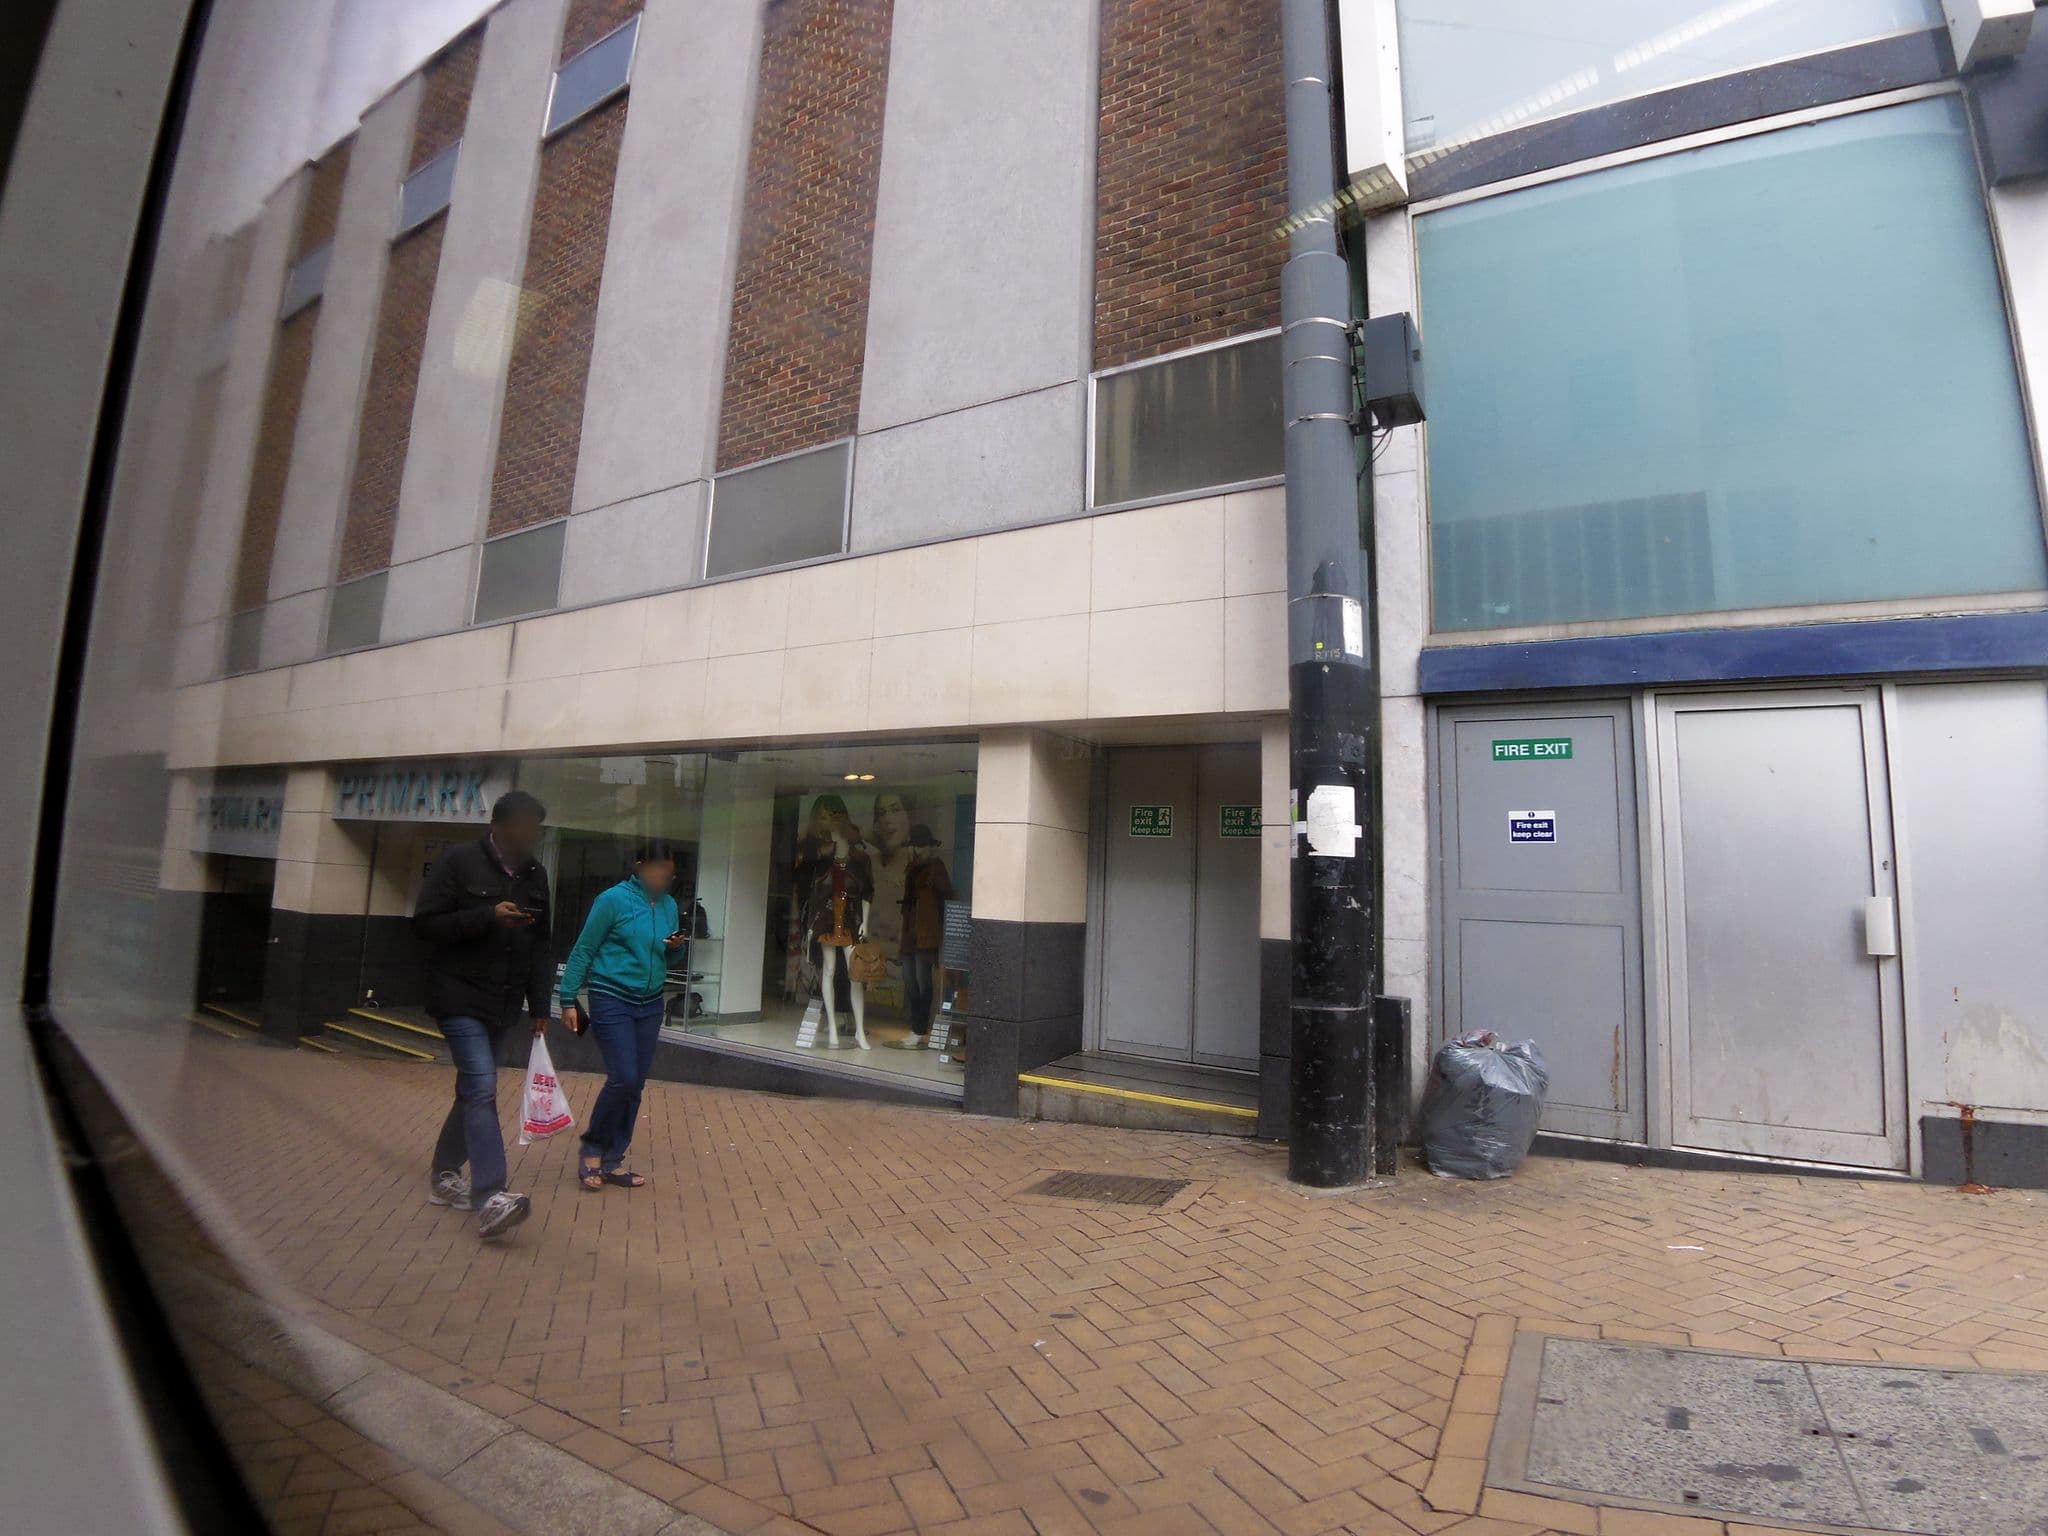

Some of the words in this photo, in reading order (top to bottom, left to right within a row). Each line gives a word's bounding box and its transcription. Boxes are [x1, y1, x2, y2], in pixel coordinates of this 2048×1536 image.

[1495, 745, 1530, 756] FIRE
[1534, 743, 1569, 755] EXIT
[338, 772, 487, 816] PRIMARK
[1135, 808, 1153, 817] Fire
[1225, 808, 1245, 817] Fire
[1135, 817, 1152, 825] exit
[1225, 817, 1245, 825] exit
[1132, 826, 1151, 835] Keep
[1513, 831, 1532, 839] keep
